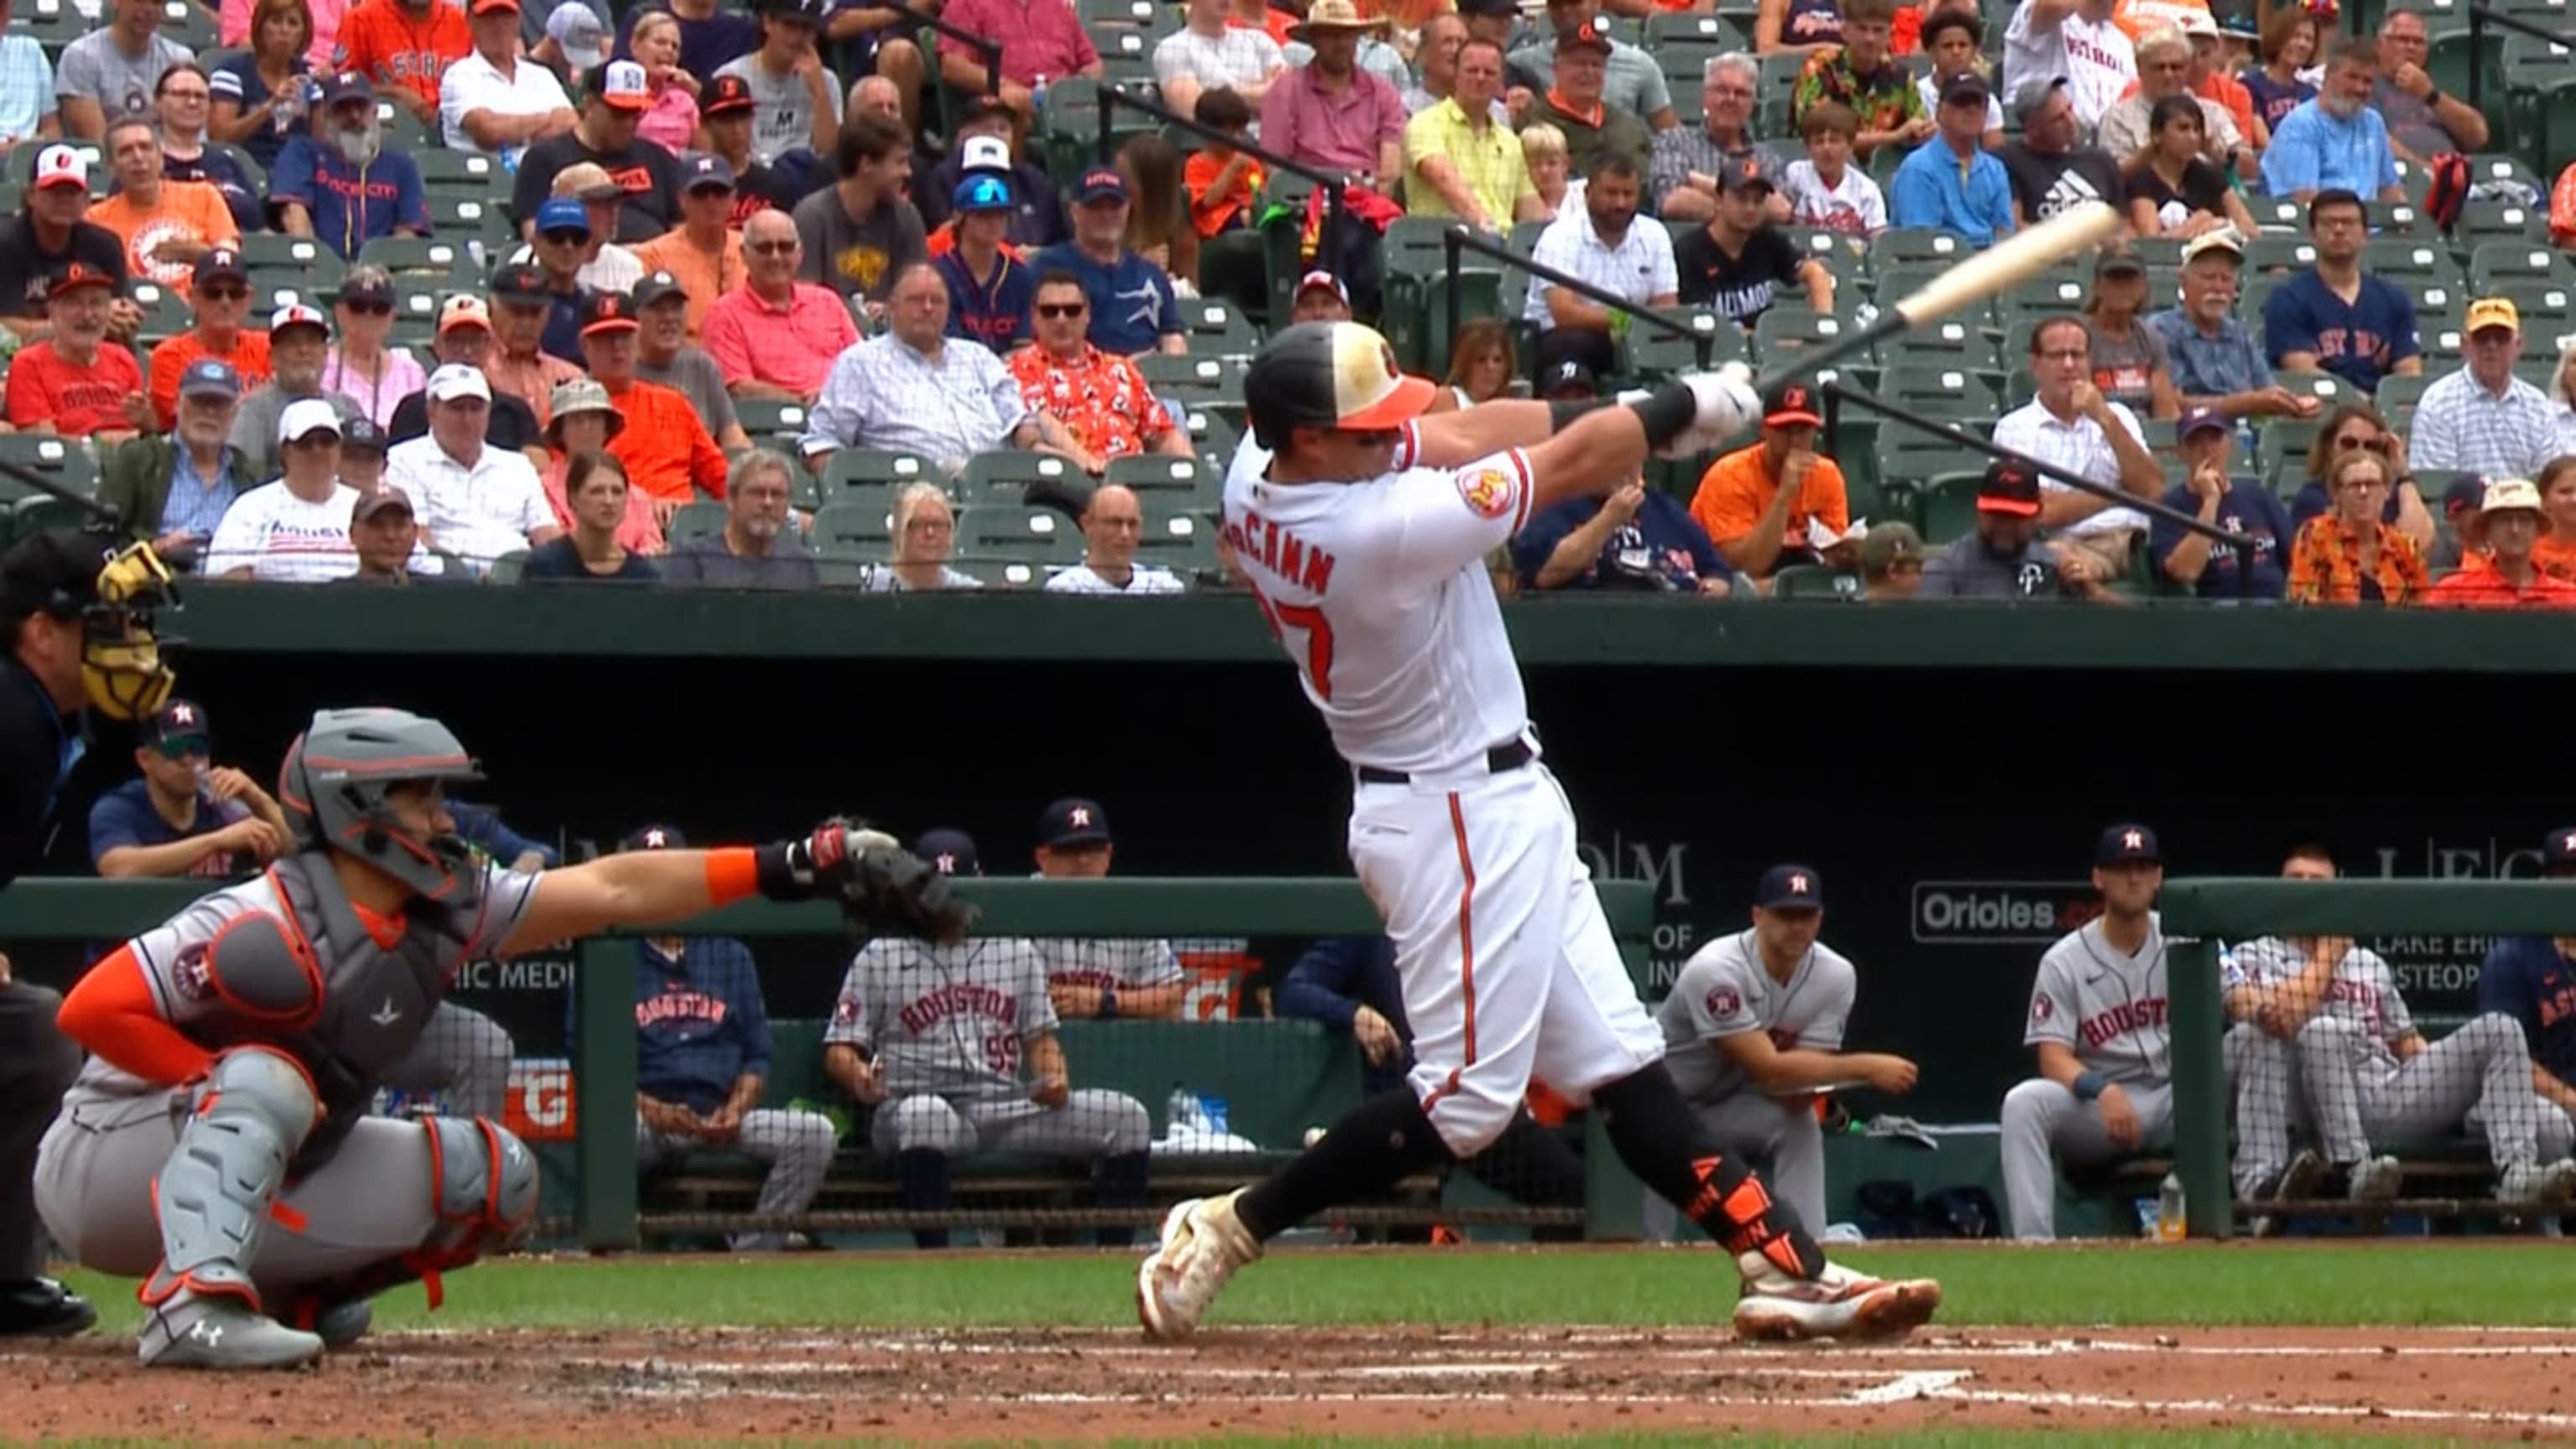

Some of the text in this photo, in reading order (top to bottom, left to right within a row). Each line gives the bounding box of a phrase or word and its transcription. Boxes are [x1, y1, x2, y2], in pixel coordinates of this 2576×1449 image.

[1223, 511, 1336, 596] cCANN
[1653, 925, 1693, 950] OF
[2391, 964, 2480, 990] STEOP
[900, 983, 1019, 1036] HOUSTON
[984, 1031, 1023, 1072] 99
